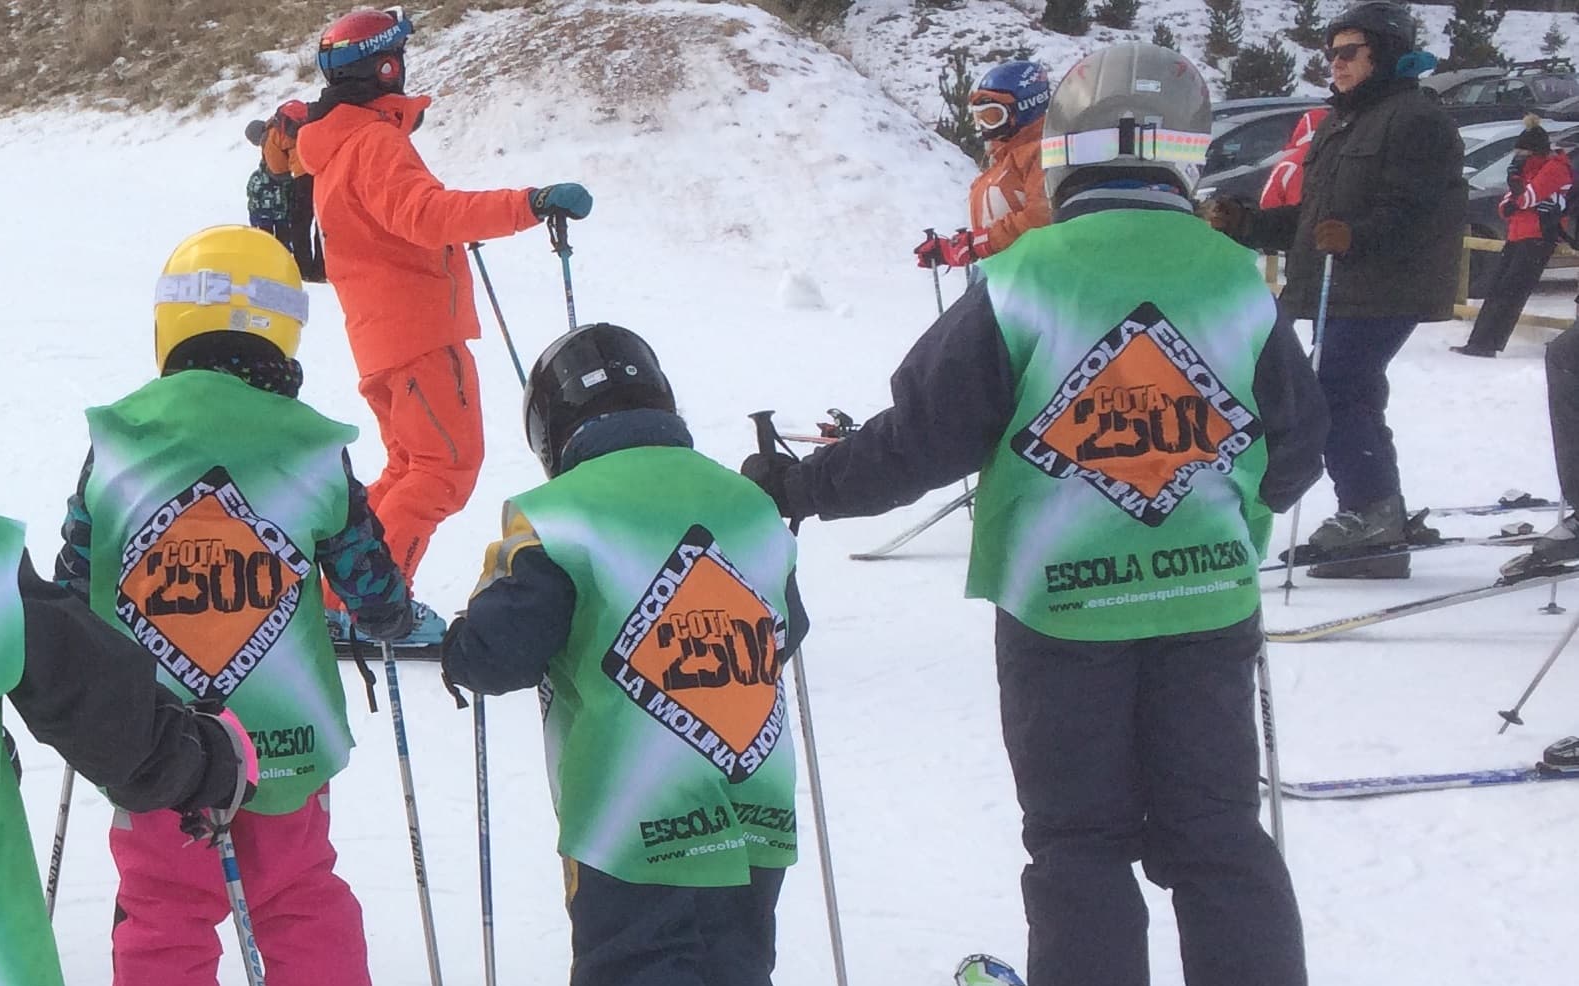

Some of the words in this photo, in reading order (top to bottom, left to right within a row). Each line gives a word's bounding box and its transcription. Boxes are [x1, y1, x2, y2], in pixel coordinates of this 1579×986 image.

[358, 25, 401, 50] SINNER
[1029, 320, 1146, 437] ESCOLA
[1093, 384, 1167, 413] COTA
[1147, 319, 1254, 431] ESQUI
[1074, 396, 1218, 462] 2500
[1023, 440, 1059, 472] LA
[162, 539, 227, 568] COTA
[1044, 554, 1145, 593] ESCOLA
[1151, 540, 1249, 579] COTA2500
[145, 548, 283, 617] 2500
[614, 544, 704, 661] ESCOLA
[1048, 577, 1253, 613] www.escolaesquilamolina.com
[671, 610, 736, 639] COTA
[134, 617, 211, 697] MOLINA
[657, 617, 780, 691] 2500
[247, 725, 315, 759] TA2500
[616, 664, 646, 701] LA
[646, 691, 737, 776] MOLINA
[640, 804, 732, 848] ESCOLA
